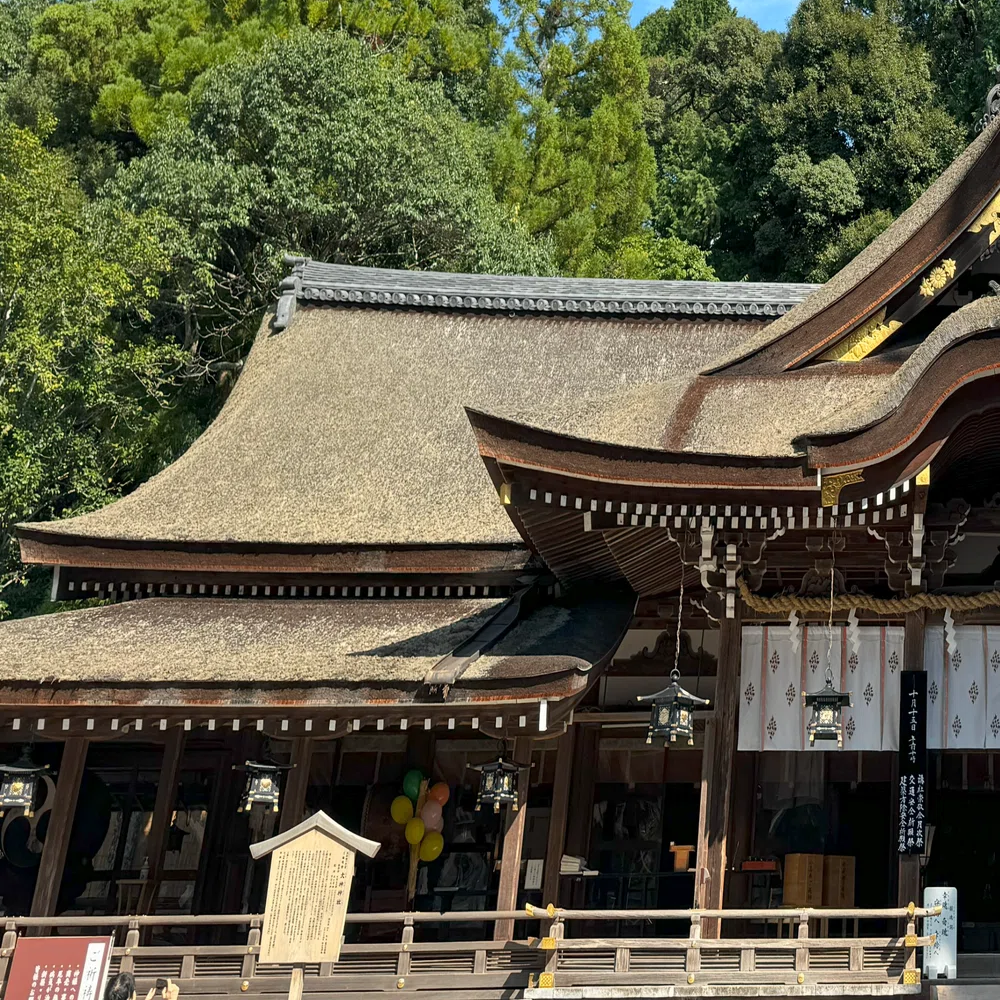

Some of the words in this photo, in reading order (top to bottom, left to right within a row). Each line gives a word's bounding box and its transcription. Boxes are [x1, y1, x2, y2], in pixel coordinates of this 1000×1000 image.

[908, 689, 919, 731] 十月十五日
[908, 735, 917, 764] 午前十時
[907, 774, 916, 847] 交通安全祈願祭
